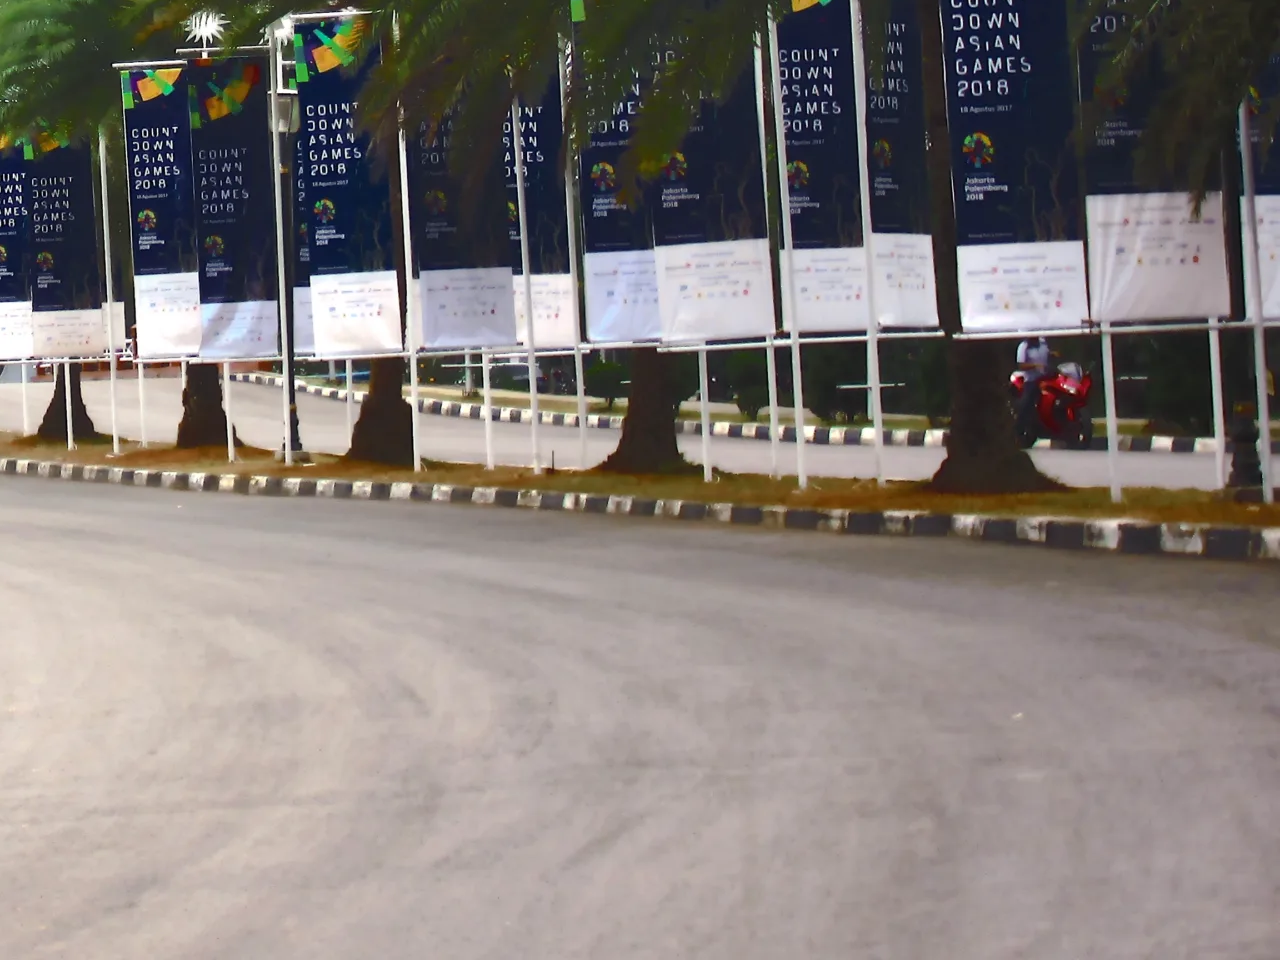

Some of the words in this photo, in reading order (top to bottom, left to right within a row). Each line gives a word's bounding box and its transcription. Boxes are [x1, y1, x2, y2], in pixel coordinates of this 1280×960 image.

[952, 13, 1019, 30] DOWN
[955, 35, 1020, 52] ASIAN
[779, 48, 839, 62] COUNT
[956, 57, 1031, 75] GAMES
[781, 84, 833, 97] ASIAN
[958, 79, 1009, 97] 2018
[782, 101, 840, 115] GAMES
[871, 96, 898, 110] 2018
[306, 102, 358, 116] COUNT
[308, 118, 354, 131] DOWN
[132, 127, 178, 138] COUNT
[309, 133, 354, 146] ASIAN
[133, 140, 173, 151] DOWN
[134, 153, 173, 164] ASIAN
[199, 148, 247, 159] COUNT
[309, 148, 361, 161] GAMES
[134, 166, 180, 177] GAMES
[200, 162, 242, 173] DOWN
[311, 163, 346, 176] 2018
[31, 177, 73, 186] COUNT
[135, 179, 166, 190] 2018
[201, 176, 242, 187] ASIAN
[33, 189, 69, 198] DOWN
[965, 184, 1008, 192] Palembang
[201, 189, 249, 200] GAMES
[966, 193, 983, 201] 2018
[34, 201, 69, 210] ASIAN
[202, 203, 234, 214] 2018
[34, 212, 75, 222] GAMES
[34, 224, 62, 233] 2018
